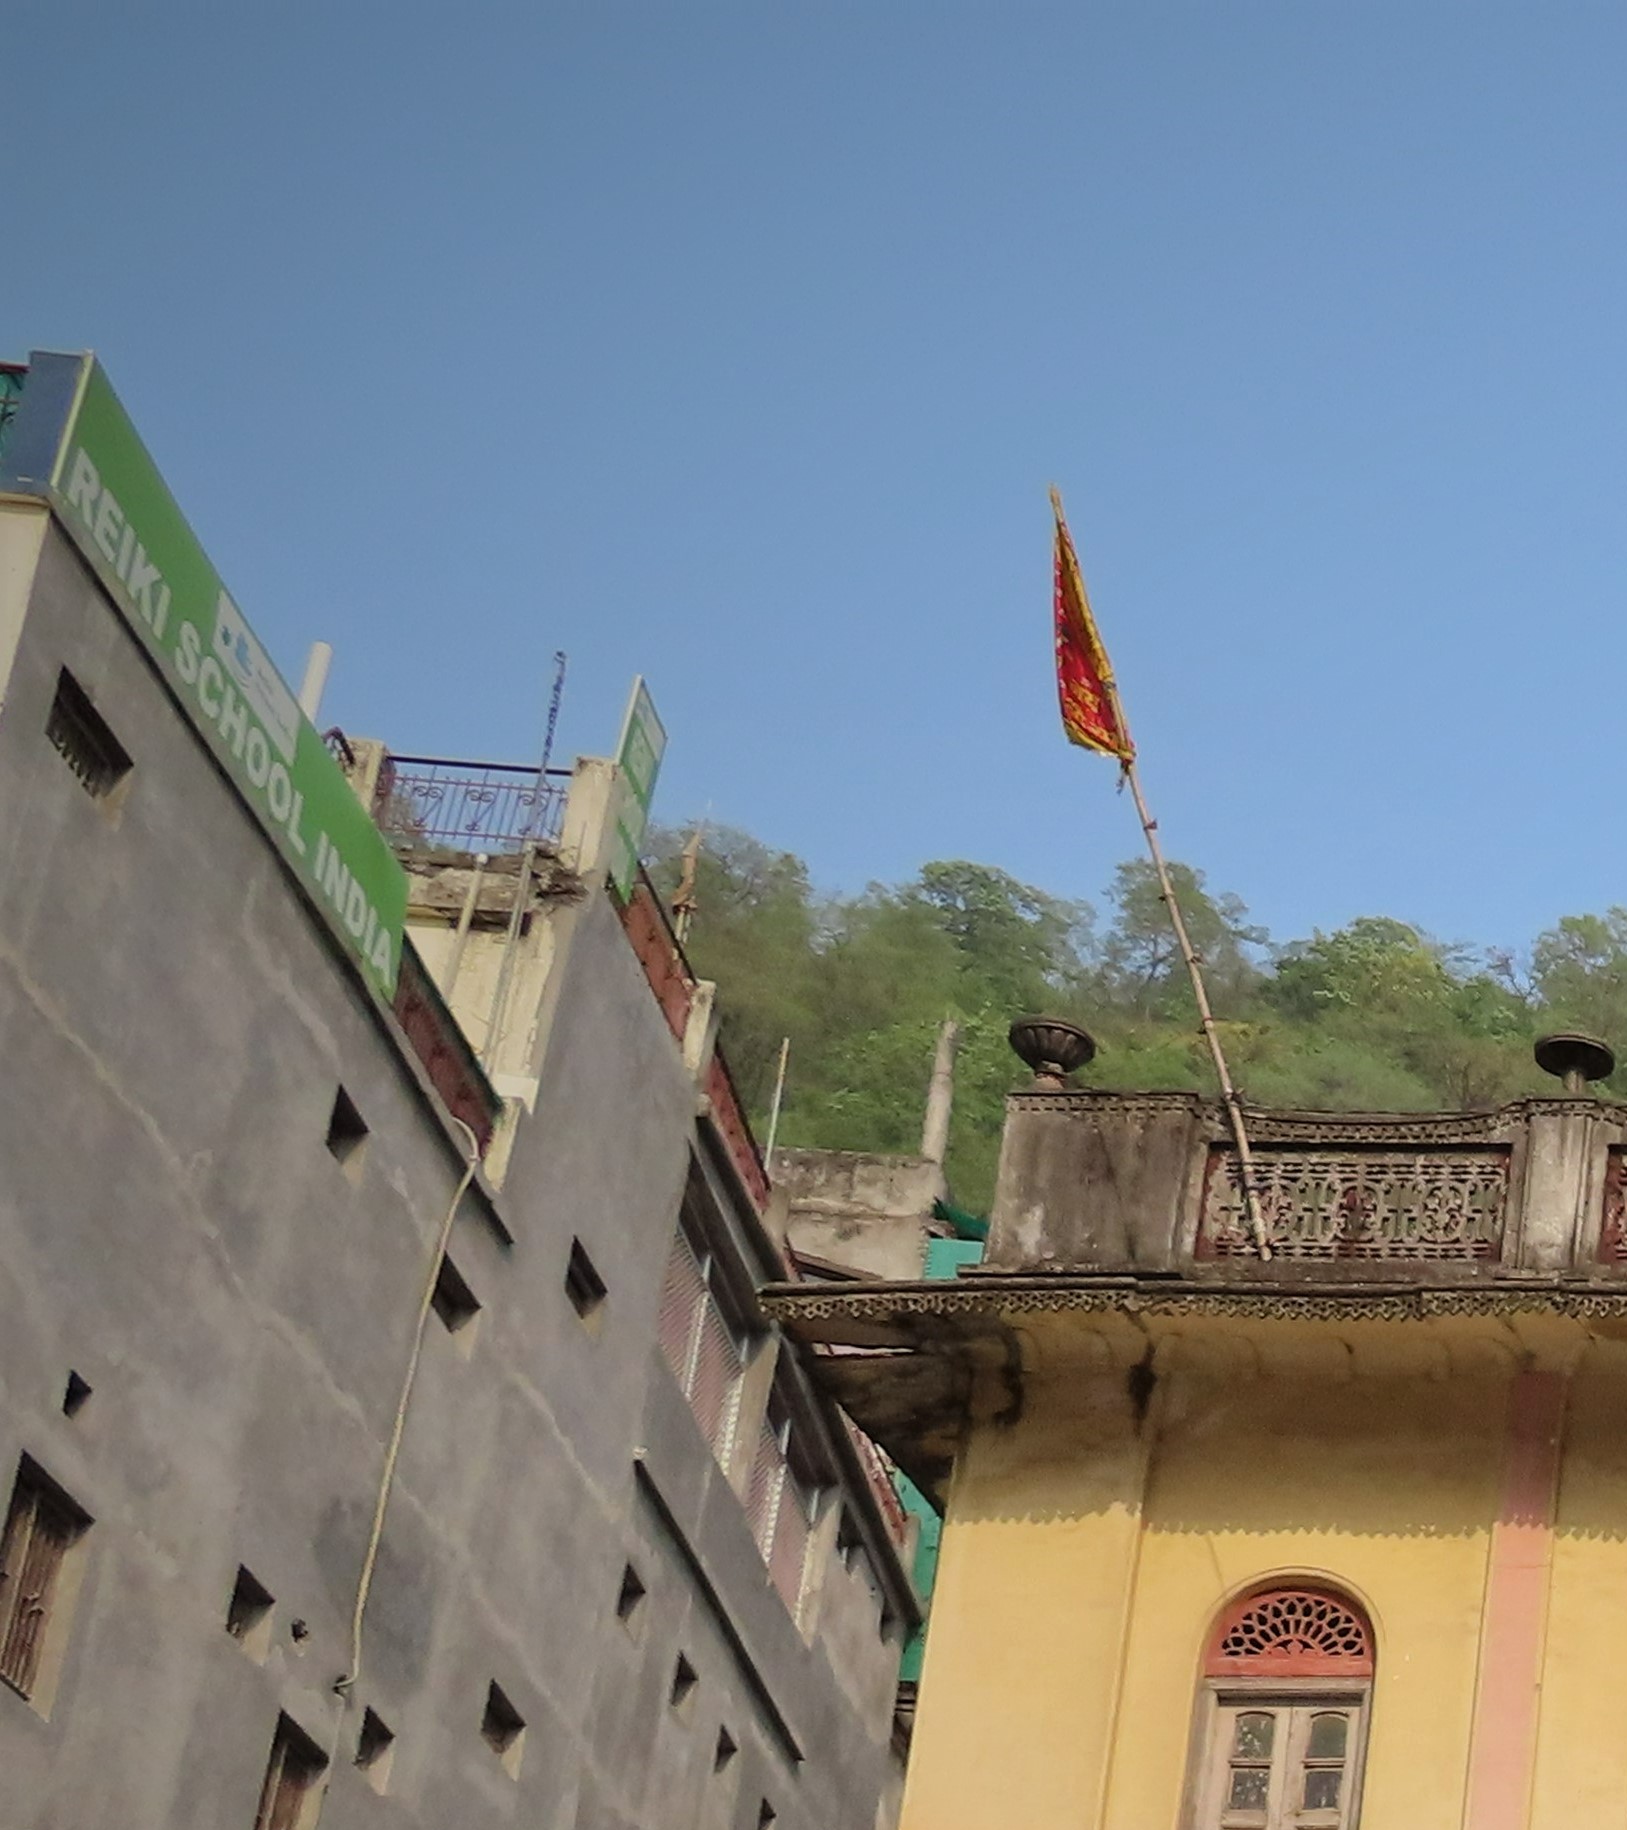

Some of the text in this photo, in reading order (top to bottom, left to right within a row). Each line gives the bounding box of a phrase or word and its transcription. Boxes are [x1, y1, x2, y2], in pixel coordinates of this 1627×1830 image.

[67, 446, 392, 989] REIKI SCHOOL INDIA
